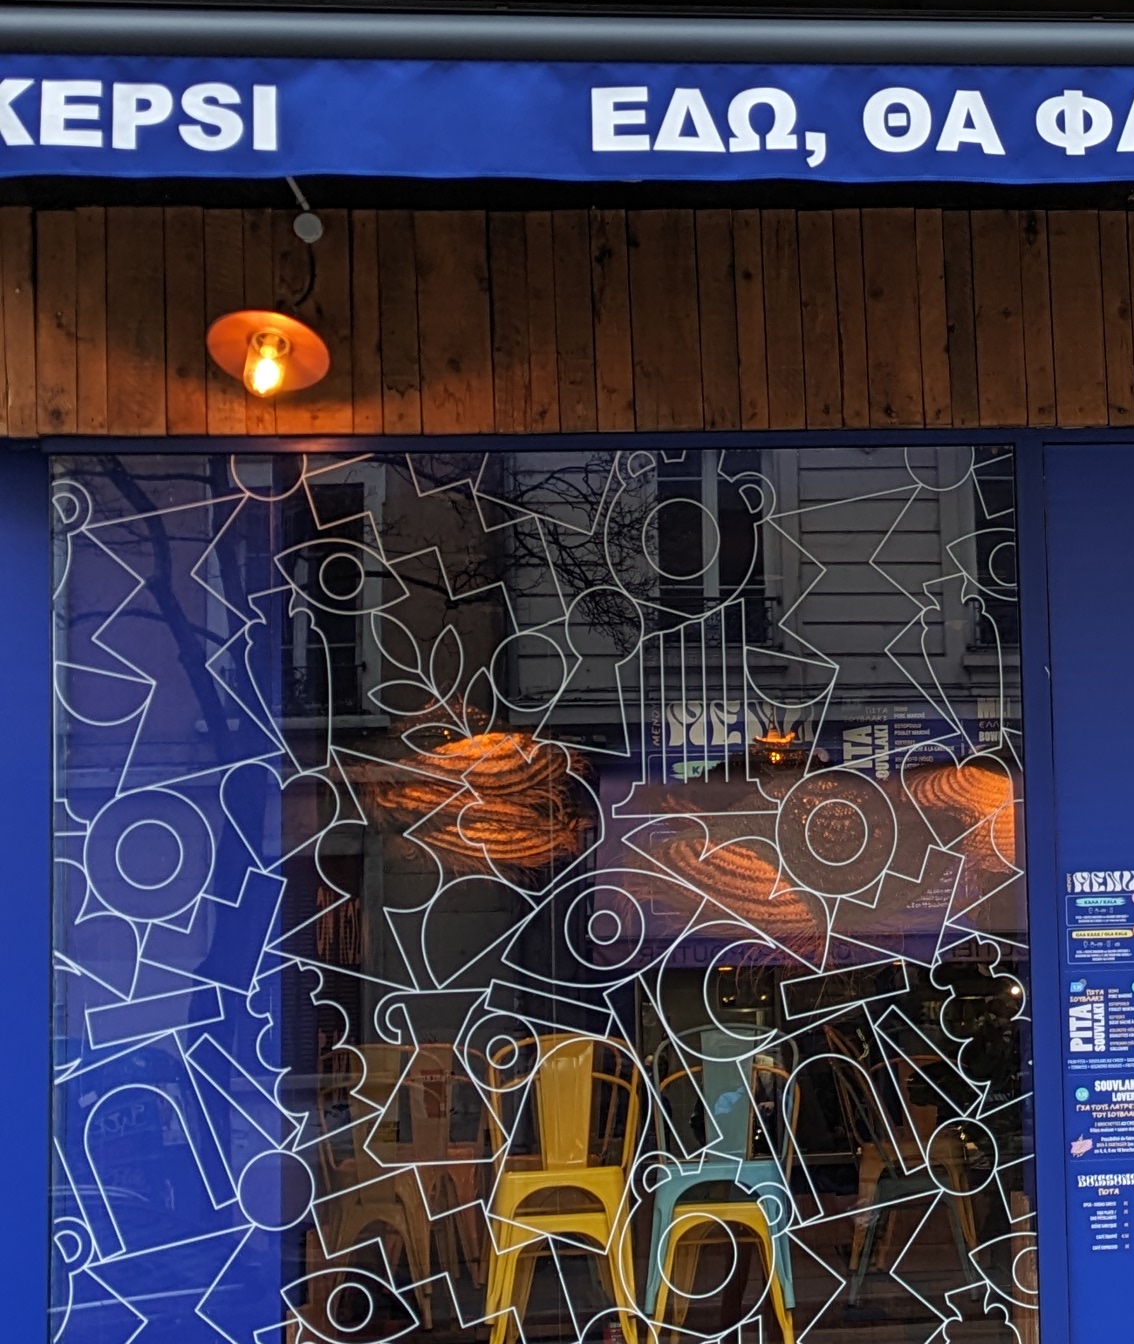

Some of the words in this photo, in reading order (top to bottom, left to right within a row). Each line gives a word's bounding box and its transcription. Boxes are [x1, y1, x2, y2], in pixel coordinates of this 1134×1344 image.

[590, 84, 828, 168] ΕΔΩ,
[862, 86, 1006, 156] ΘΑ
[1068, 1003, 1094, 1052] PITA
[1092, 1002, 1106, 1053] SOUVLAKI
